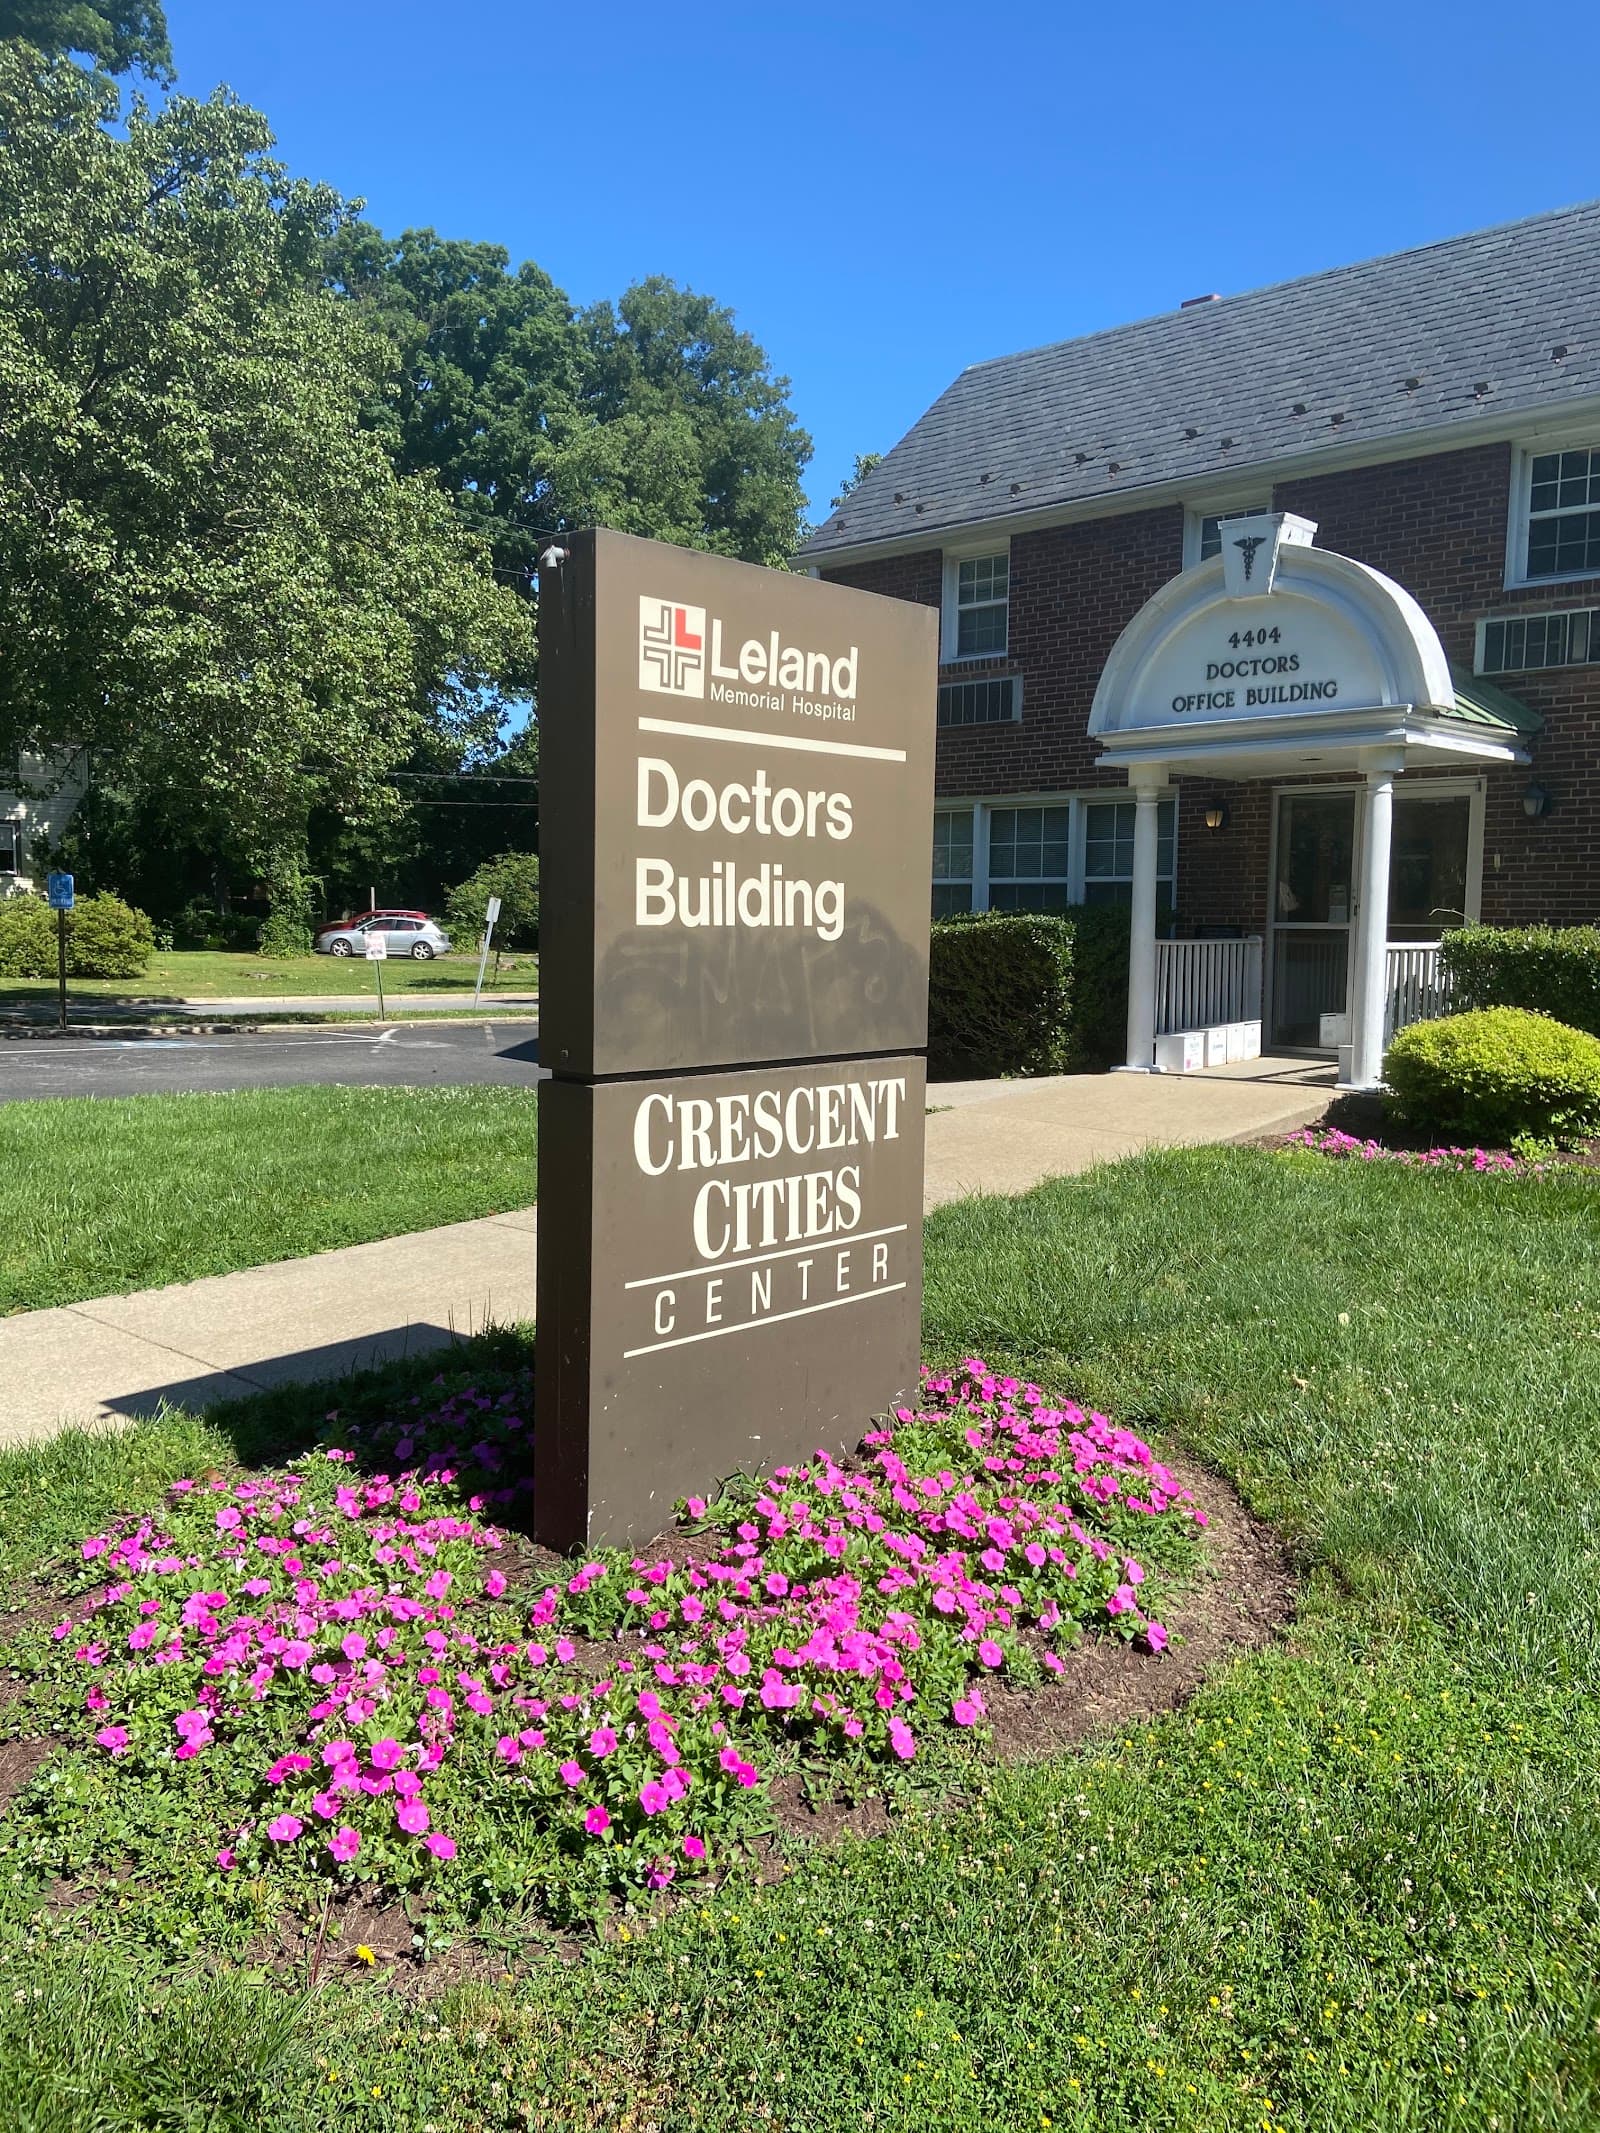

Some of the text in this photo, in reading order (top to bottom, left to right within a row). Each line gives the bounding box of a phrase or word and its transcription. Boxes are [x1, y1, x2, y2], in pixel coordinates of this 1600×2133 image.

[711, 619, 858, 699] Leland
[1206, 654, 1300, 681] DOCTORS
[1228, 626, 1282, 649] 4404
[710, 683, 855, 721] Memorial Hospital
[1172, 681, 1338, 713] OFFICE BUILDING
[637, 757, 853, 840] Doctors
[635, 857, 845, 941] Building
[633, 1078, 905, 1175] CRESCENT
[693, 1166, 861, 1259] CITIES
[654, 1243, 888, 1335] CENTER
